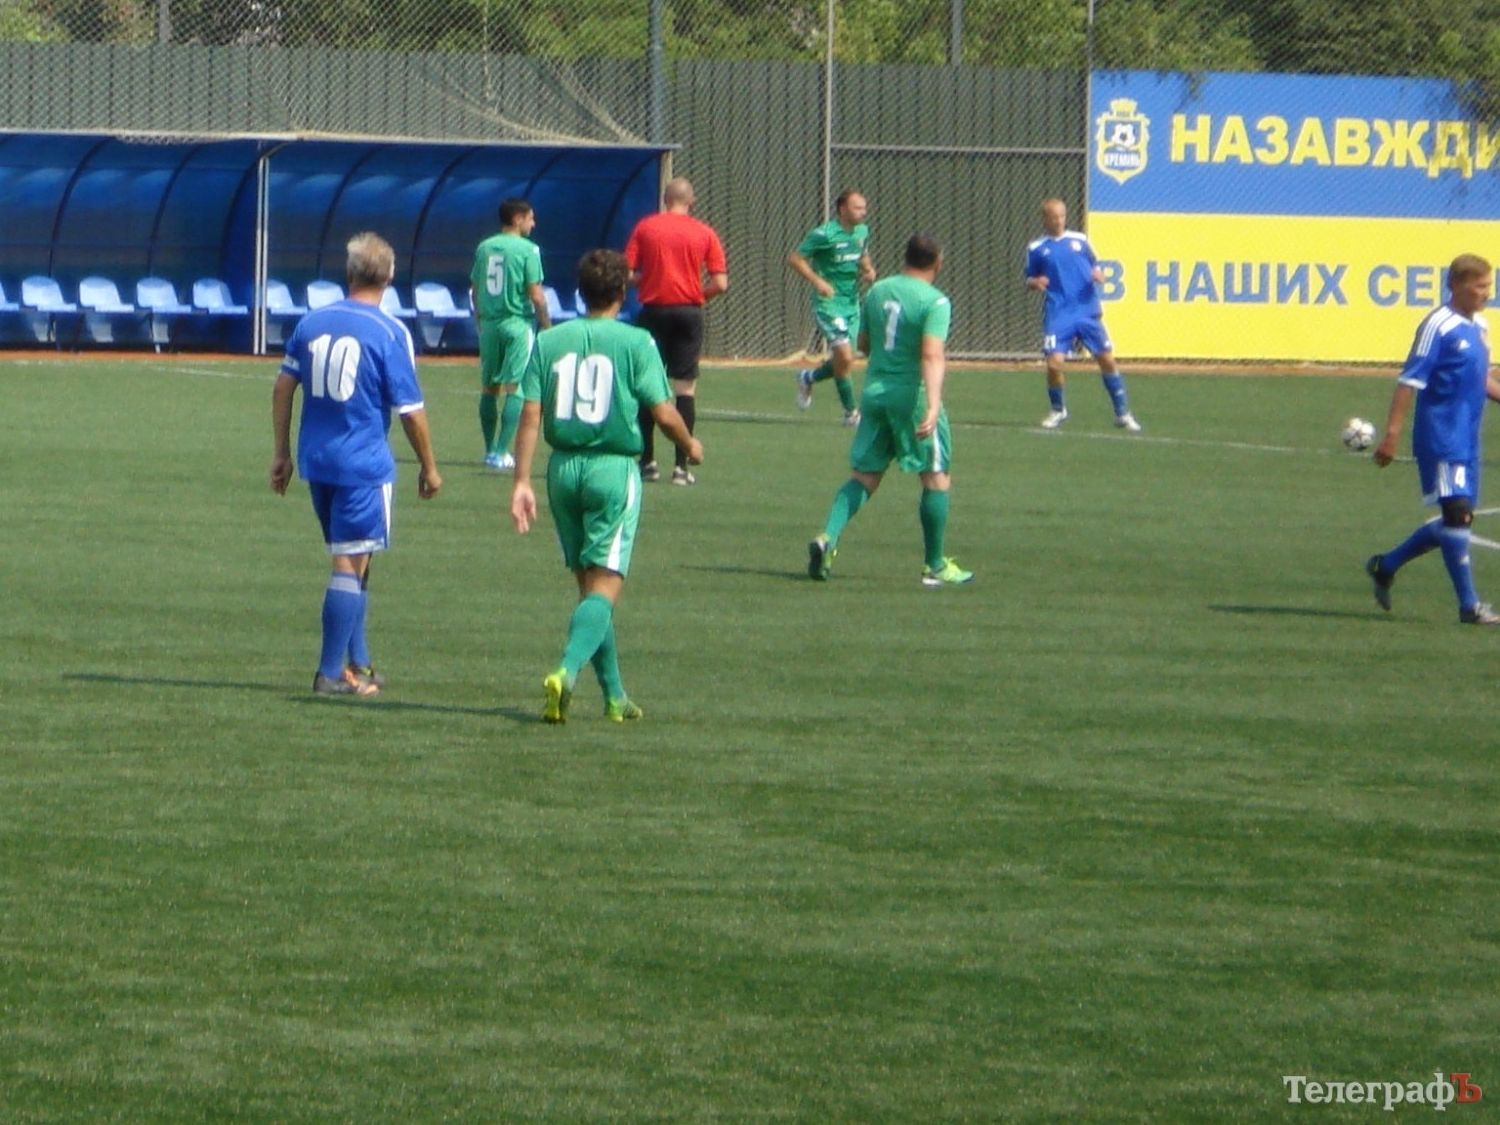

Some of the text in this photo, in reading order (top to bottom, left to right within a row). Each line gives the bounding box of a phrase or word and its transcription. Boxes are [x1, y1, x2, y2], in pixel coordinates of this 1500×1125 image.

[486, 254, 504, 297] 5
[1146, 261, 1348, 305] НАШИХ
[308, 333, 361, 402] 10
[553, 352, 613, 424] 19
